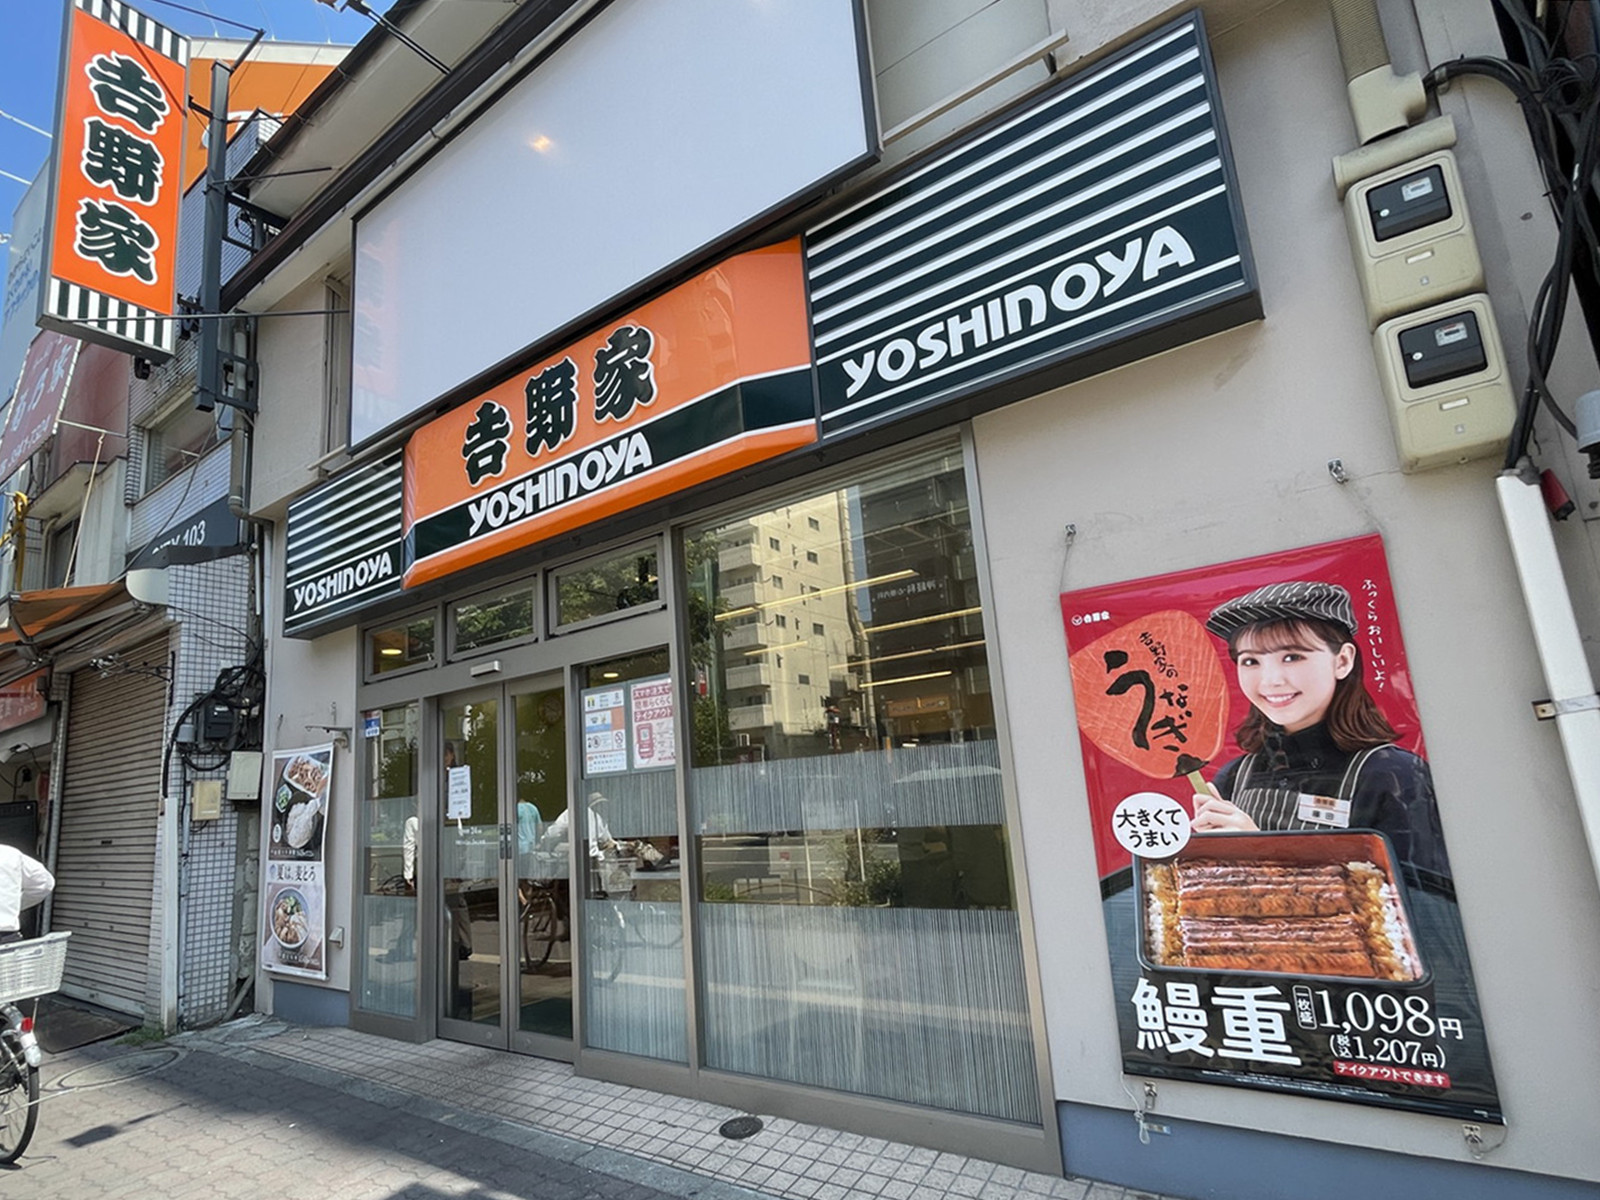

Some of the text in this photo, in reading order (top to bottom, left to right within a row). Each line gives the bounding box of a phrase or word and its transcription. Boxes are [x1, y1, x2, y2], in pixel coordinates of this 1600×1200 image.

[74, 50, 170, 285] 吉野家
[842, 225, 1195, 398] YOSHINOYA
[462, 324, 658, 487] 吉野家
[468, 432, 652, 537] YOSHINOYA
[294, 551, 393, 611] YOSHINOYA
[1103, 650, 1192, 752] うなぎ
[1116, 808, 1181, 828] 大きくて
[1129, 829, 1179, 848] うまい
[1131, 977, 1301, 1066] 鰻重
[1337, 1062, 1446, 1086] テイクアウトできます
